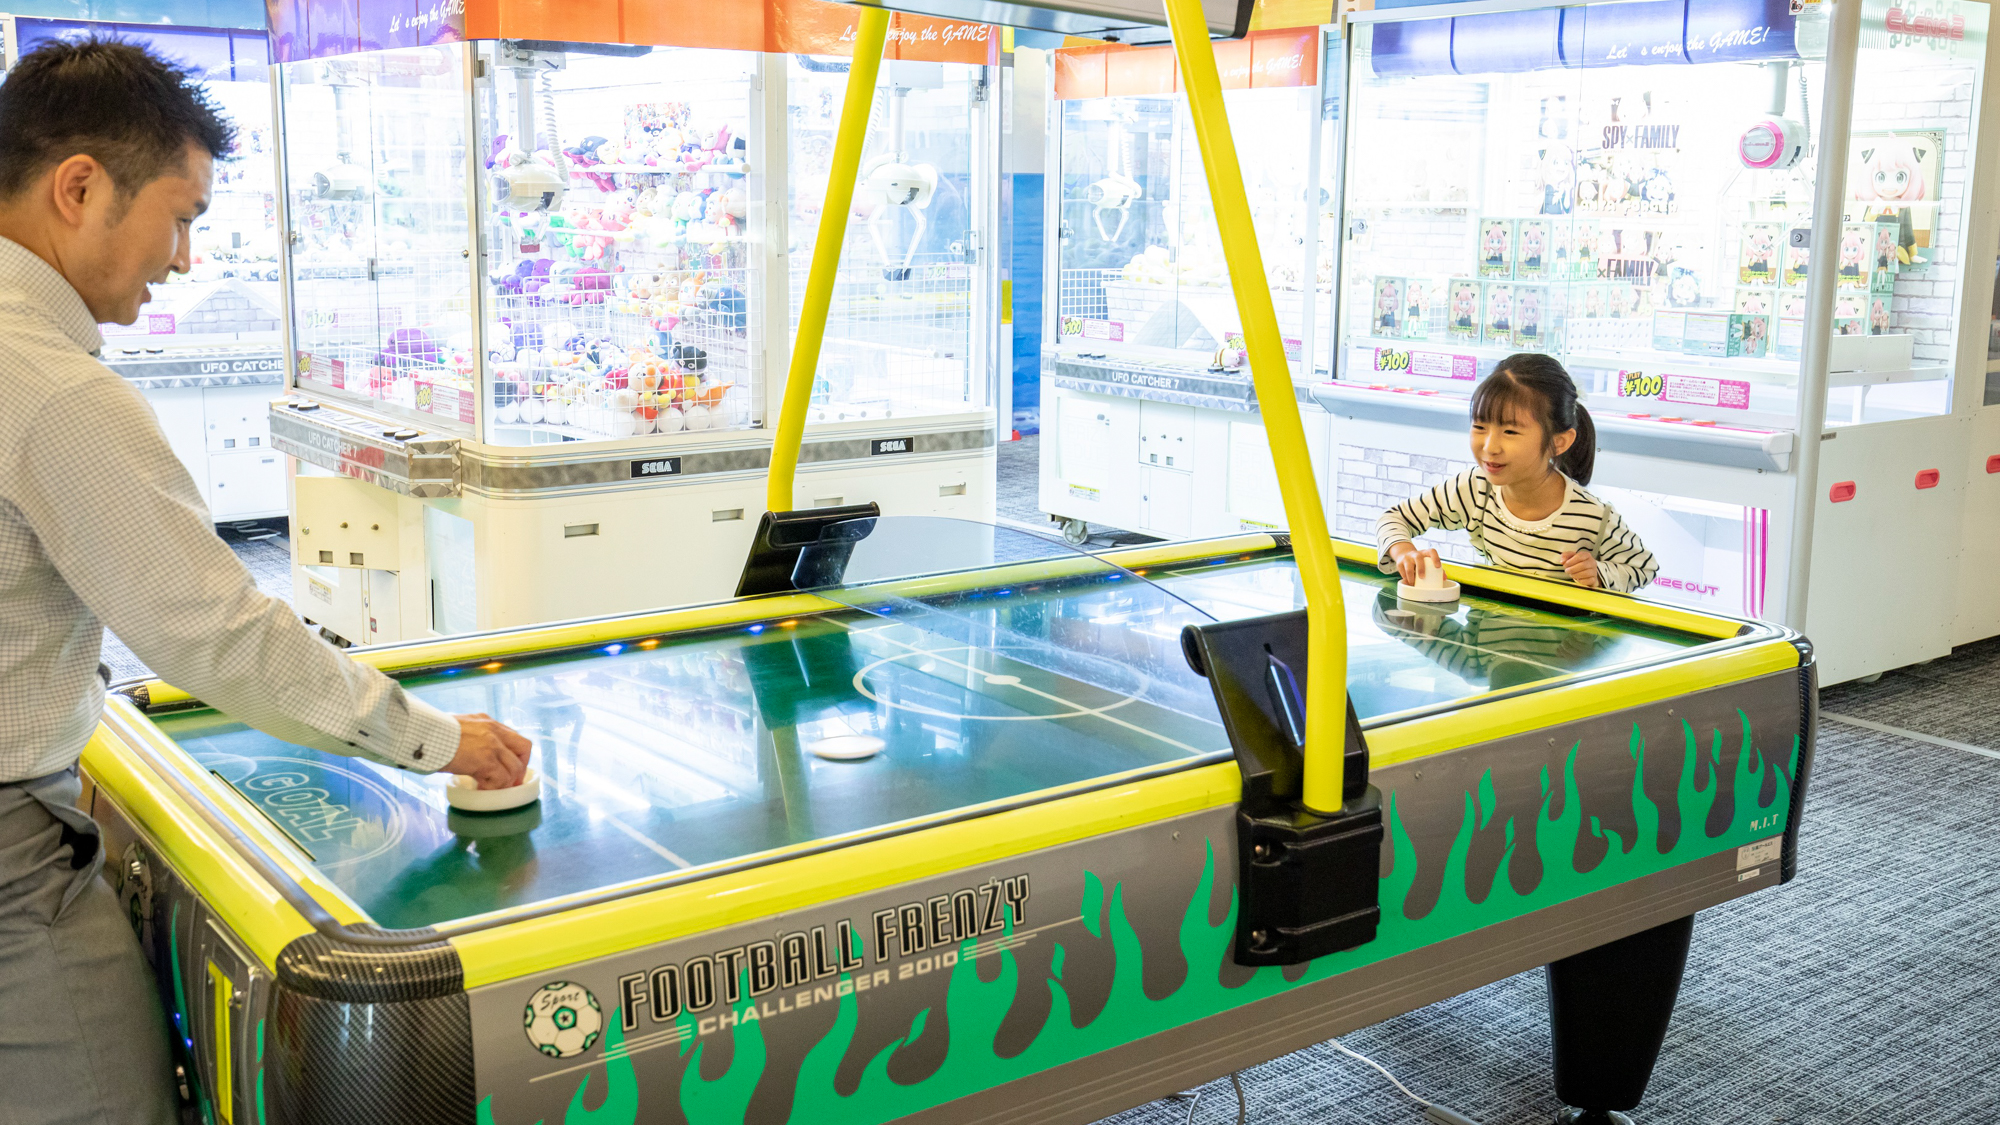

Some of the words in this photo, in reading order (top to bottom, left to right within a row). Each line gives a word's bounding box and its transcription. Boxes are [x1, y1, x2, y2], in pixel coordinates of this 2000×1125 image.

[411, 11, 428, 30] enjoy
[430, 4, 439, 22] the
[921, 25, 938, 41] the
[942, 24, 993, 46] GAME!
[1651, 41, 1682, 57] enjoy
[1686, 34, 1705, 51] the
[1709, 26, 1771, 53] GAME!
[1251, 61, 1264, 74] the
[1266, 54, 1304, 75] GAME!
[201, 362, 230, 374] UFO
[232, 360, 284, 372] CATCHE
[1379, 351, 1409, 371] ¥100
[1111, 371, 1130, 383] UFO
[1131, 374, 1172, 389] CATCHER
[1173, 379, 1180, 390] 7
[1624, 375, 1663, 397] ¥100
[308, 430, 321, 446] UFO
[321, 436, 352, 457] CATCHER
[352, 445, 358, 459] 7
[880, 440, 906, 452] SEGA
[641, 460, 673, 475] SEGA
[1653, 577, 1682, 590] IZE
[1685, 582, 1719, 596] OUT
[245, 772, 364, 842] GOAL
[1749, 813, 1779, 832] M.I.T
[618, 919, 864, 1034] FOOTBALL
[873, 874, 1031, 965] FRENZY
[699, 968, 891, 1036] CHALLENGER
[898, 950, 959, 980] 2010
